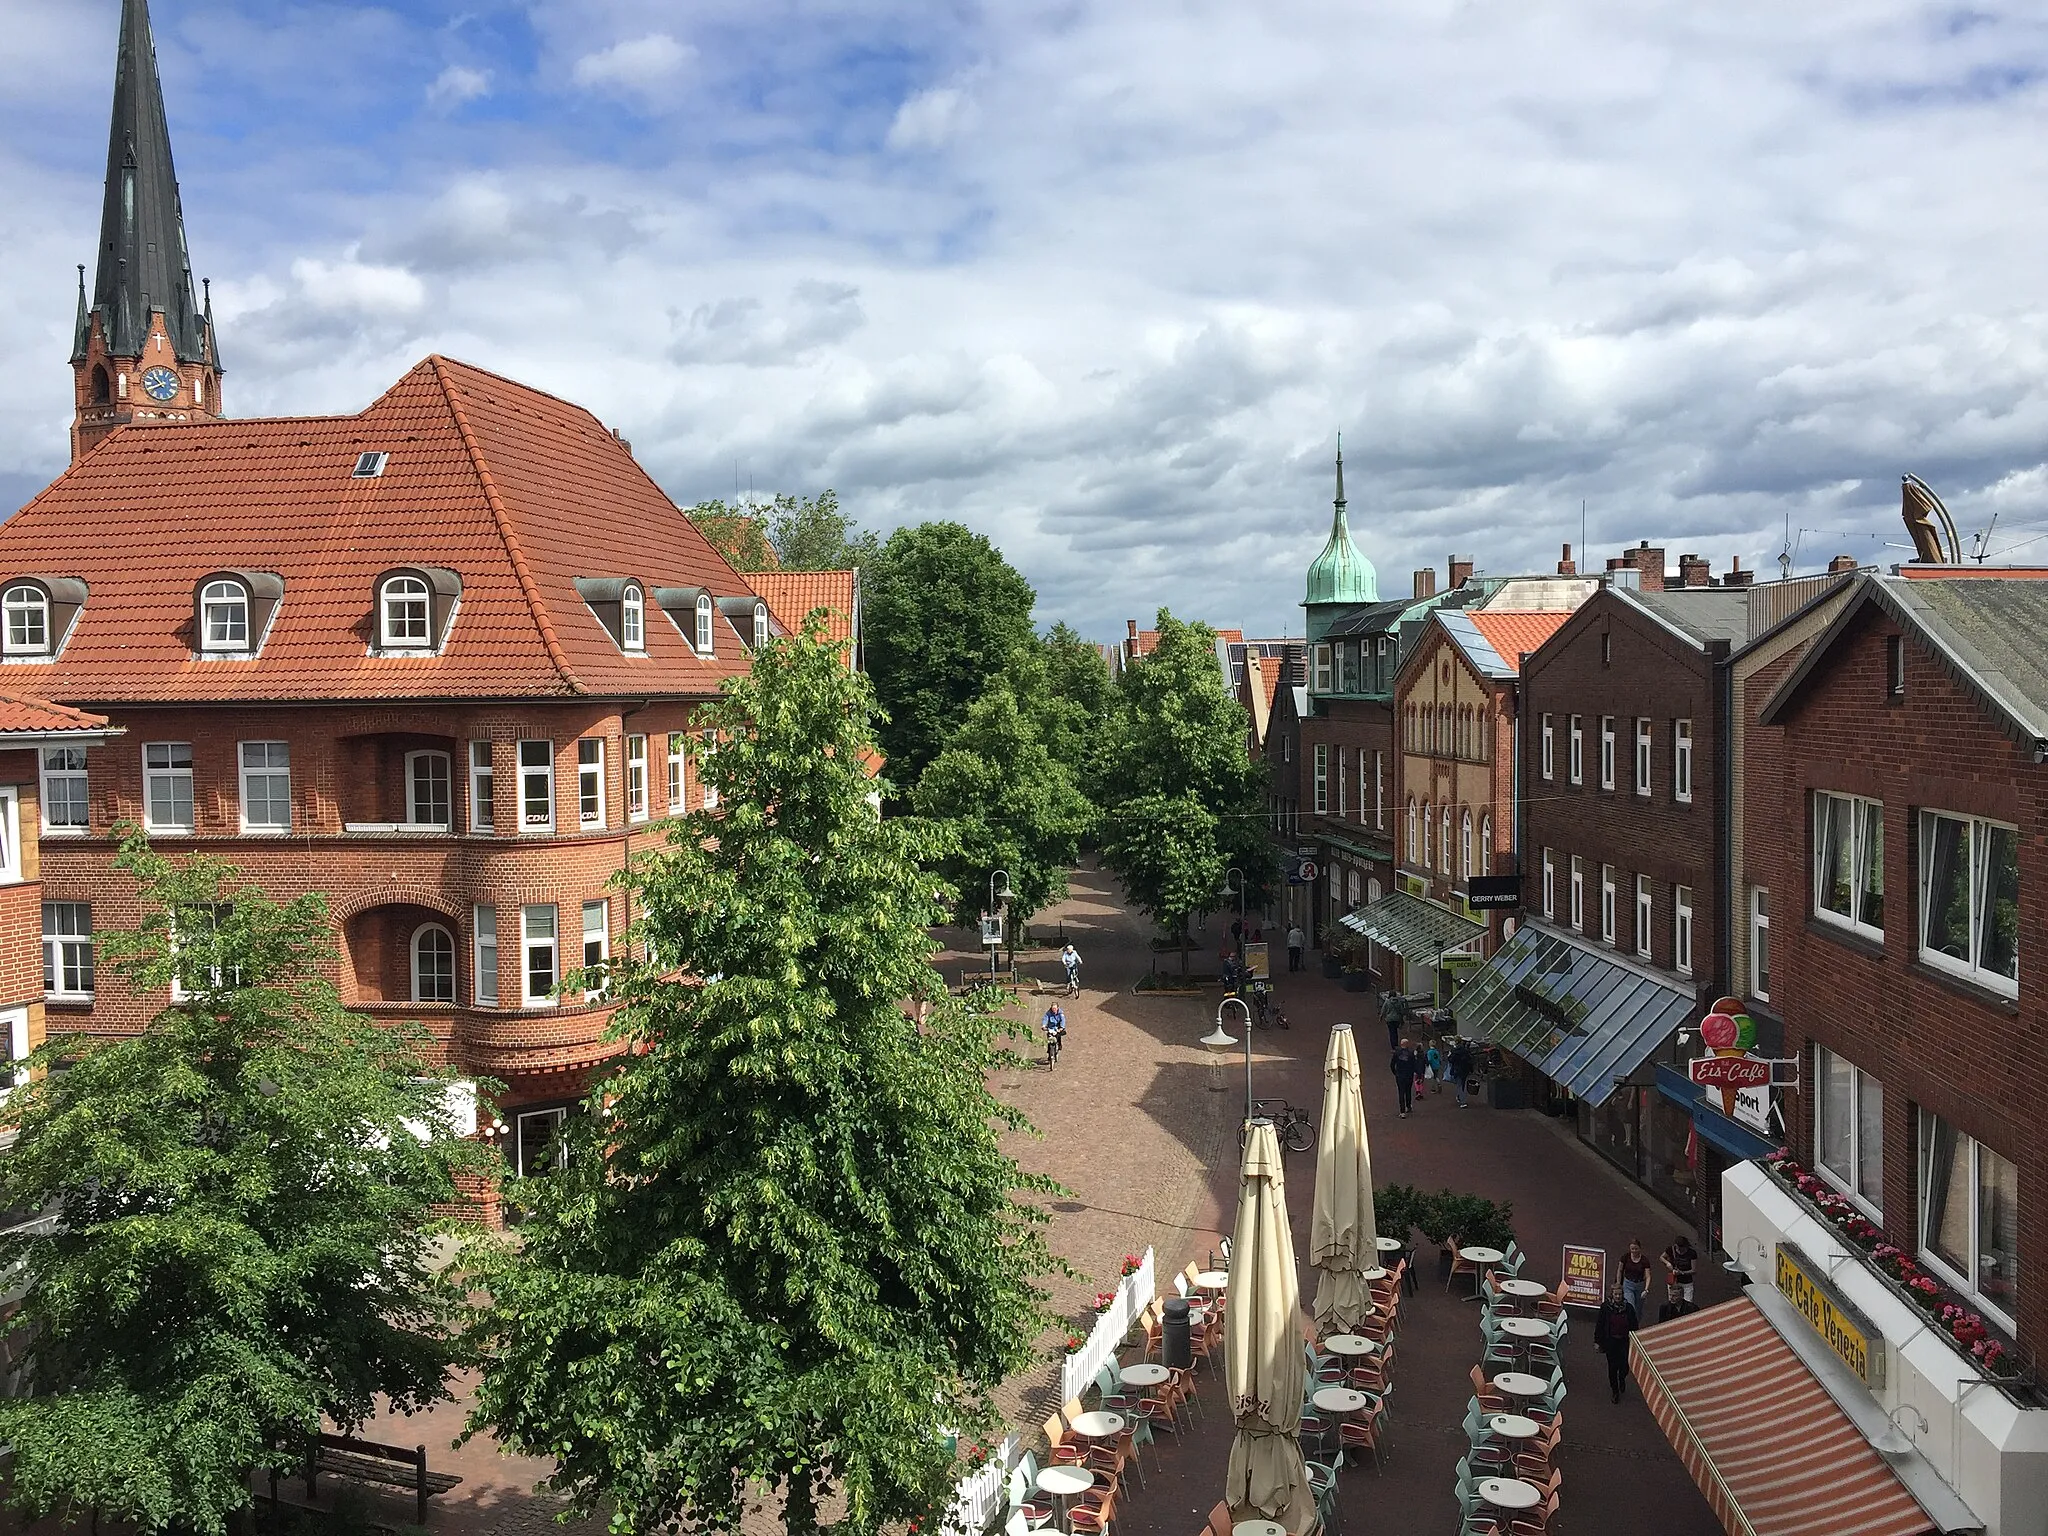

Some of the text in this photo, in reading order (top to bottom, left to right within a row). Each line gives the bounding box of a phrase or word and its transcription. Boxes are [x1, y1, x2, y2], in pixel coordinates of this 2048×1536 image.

[526, 814, 549, 822] CDU
[581, 811, 599, 820] CDU
[1471, 894, 1517, 903] GERRY WEBER
[1696, 1062, 1765, 1082] Eis-Café
[1571, 1254, 1598, 1270] 40%
[1568, 1267, 1600, 1278] AUF ALLES
[1777, 1252, 1866, 1381] Eis Cafe Venezia
